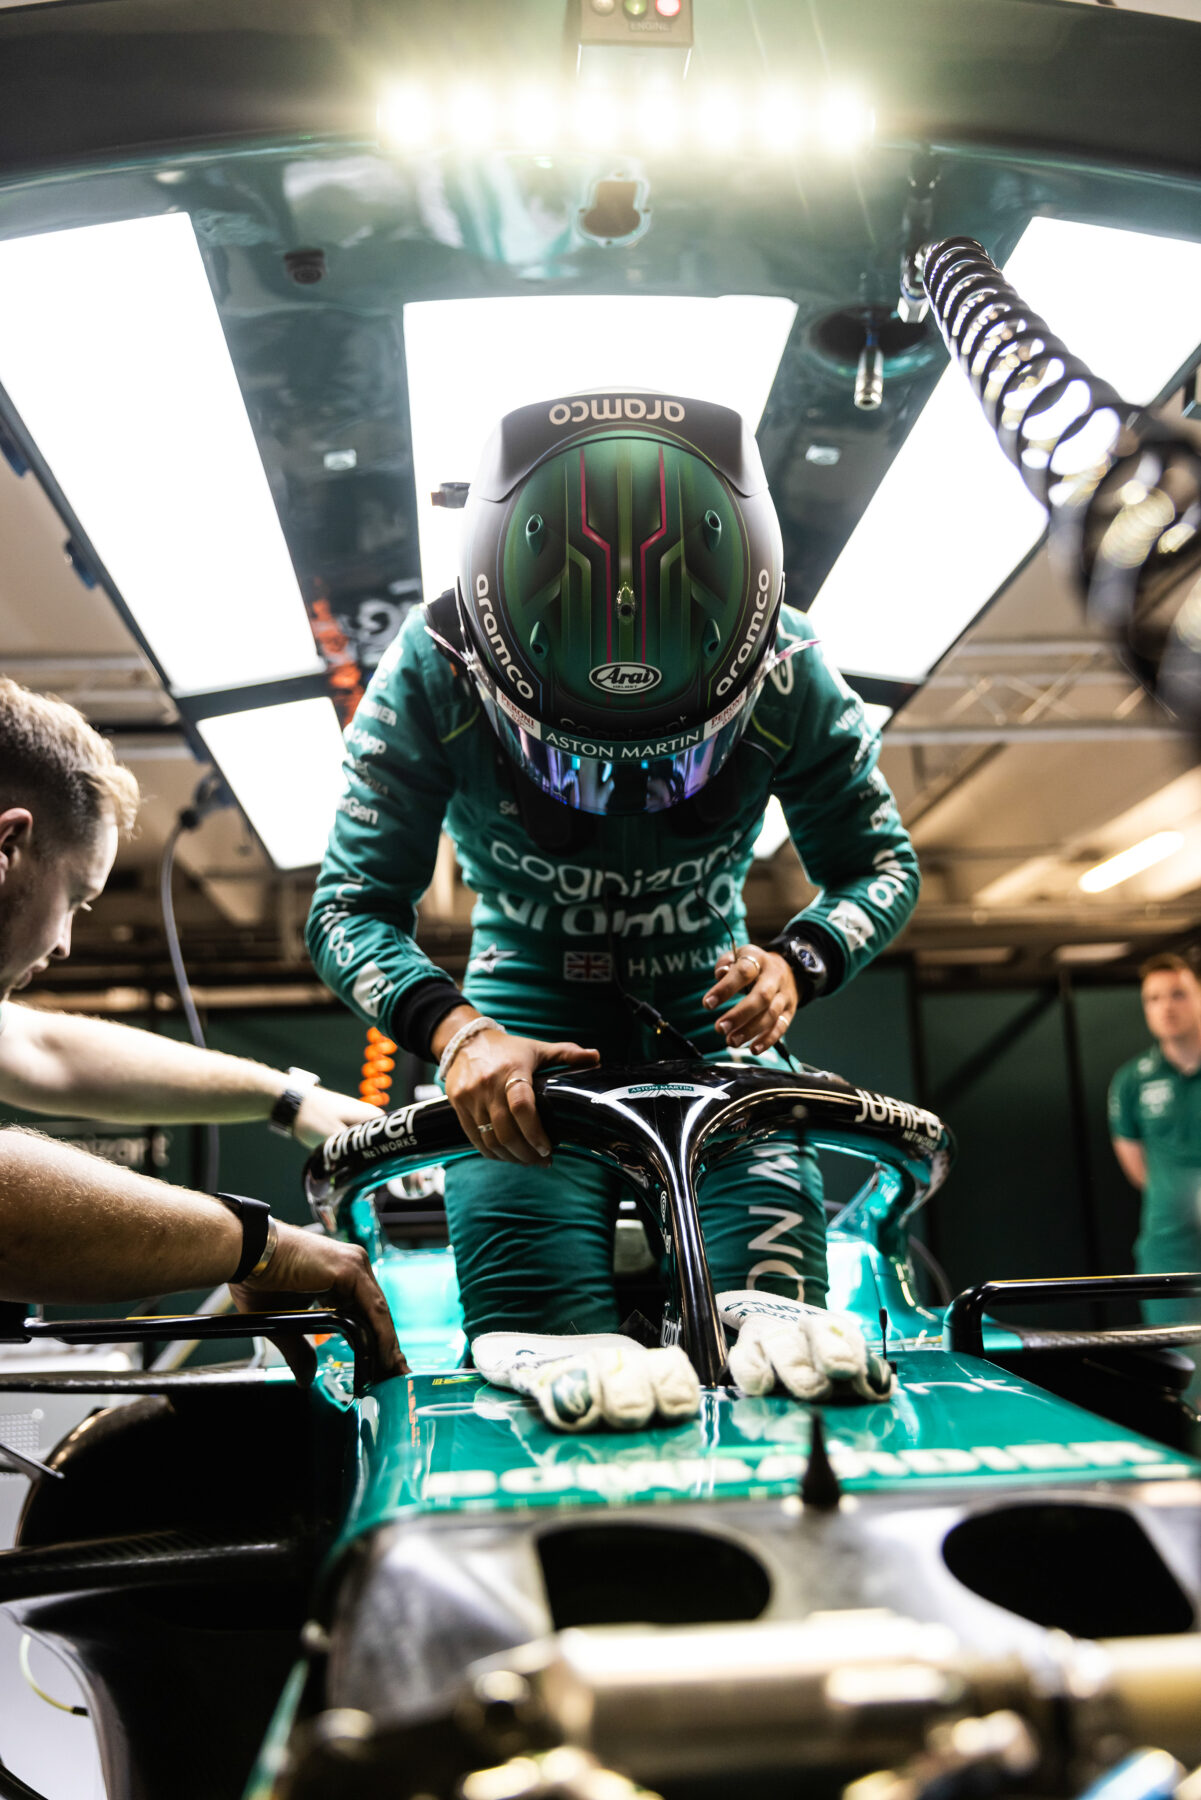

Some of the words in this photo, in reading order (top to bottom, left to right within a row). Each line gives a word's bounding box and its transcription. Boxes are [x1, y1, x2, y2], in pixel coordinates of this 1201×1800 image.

[549, 398, 686, 425] aramco
[476, 573, 534, 700] aramco
[716, 569, 770, 697] aramco
[597, 667, 651, 684] Arai
[545, 732, 614, 758] ASTON
[621, 731, 700, 759] MARTIN
[628, 942, 735, 977] HAWKIN
